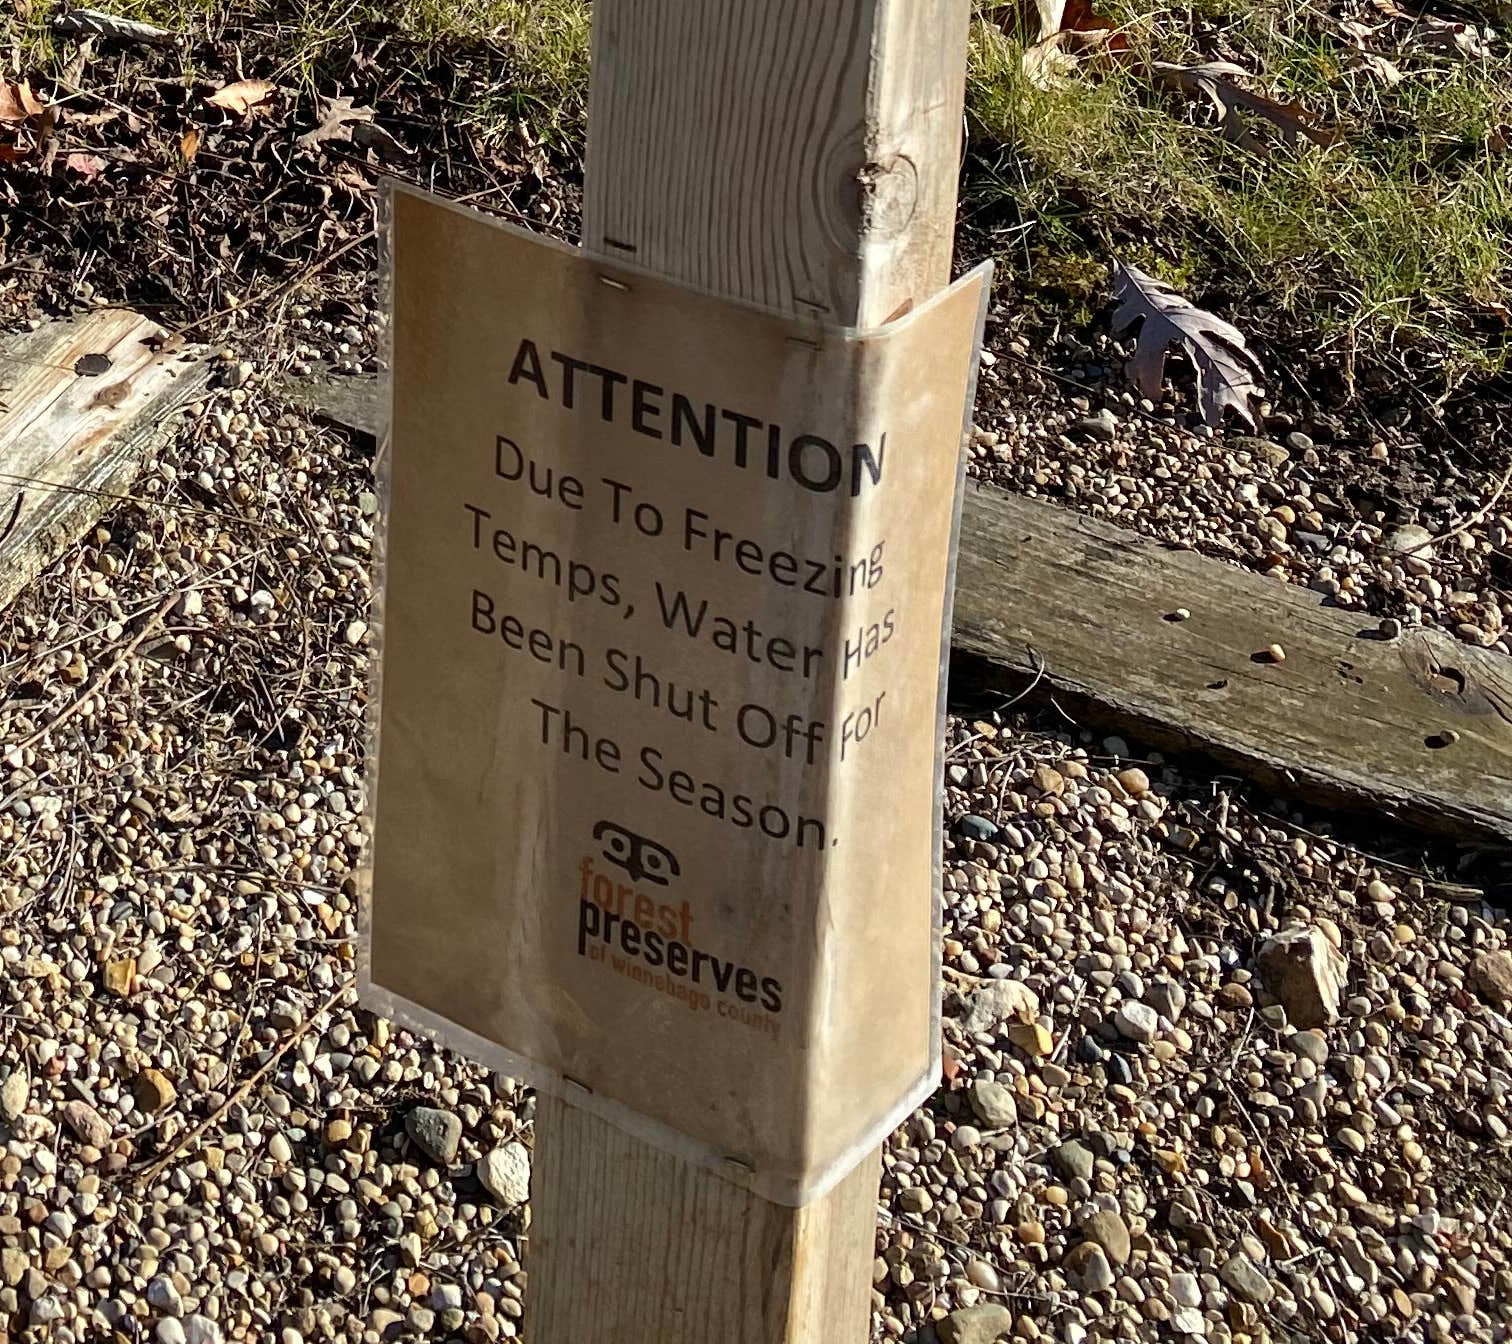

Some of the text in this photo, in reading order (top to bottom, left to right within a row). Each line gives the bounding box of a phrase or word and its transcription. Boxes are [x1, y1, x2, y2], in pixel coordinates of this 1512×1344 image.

[507, 338, 887, 498] ATTENTION
[463, 502, 896, 681] Temps, Water Has
[495, 434, 886, 600] Due To Freezing
[470, 588, 887, 766] Been Shut Off For
[530, 698, 839, 851] The Season.
[577, 897, 783, 1013] preserves
[579, 856, 695, 948] forest
[590, 944, 782, 1041] of winnebago county
